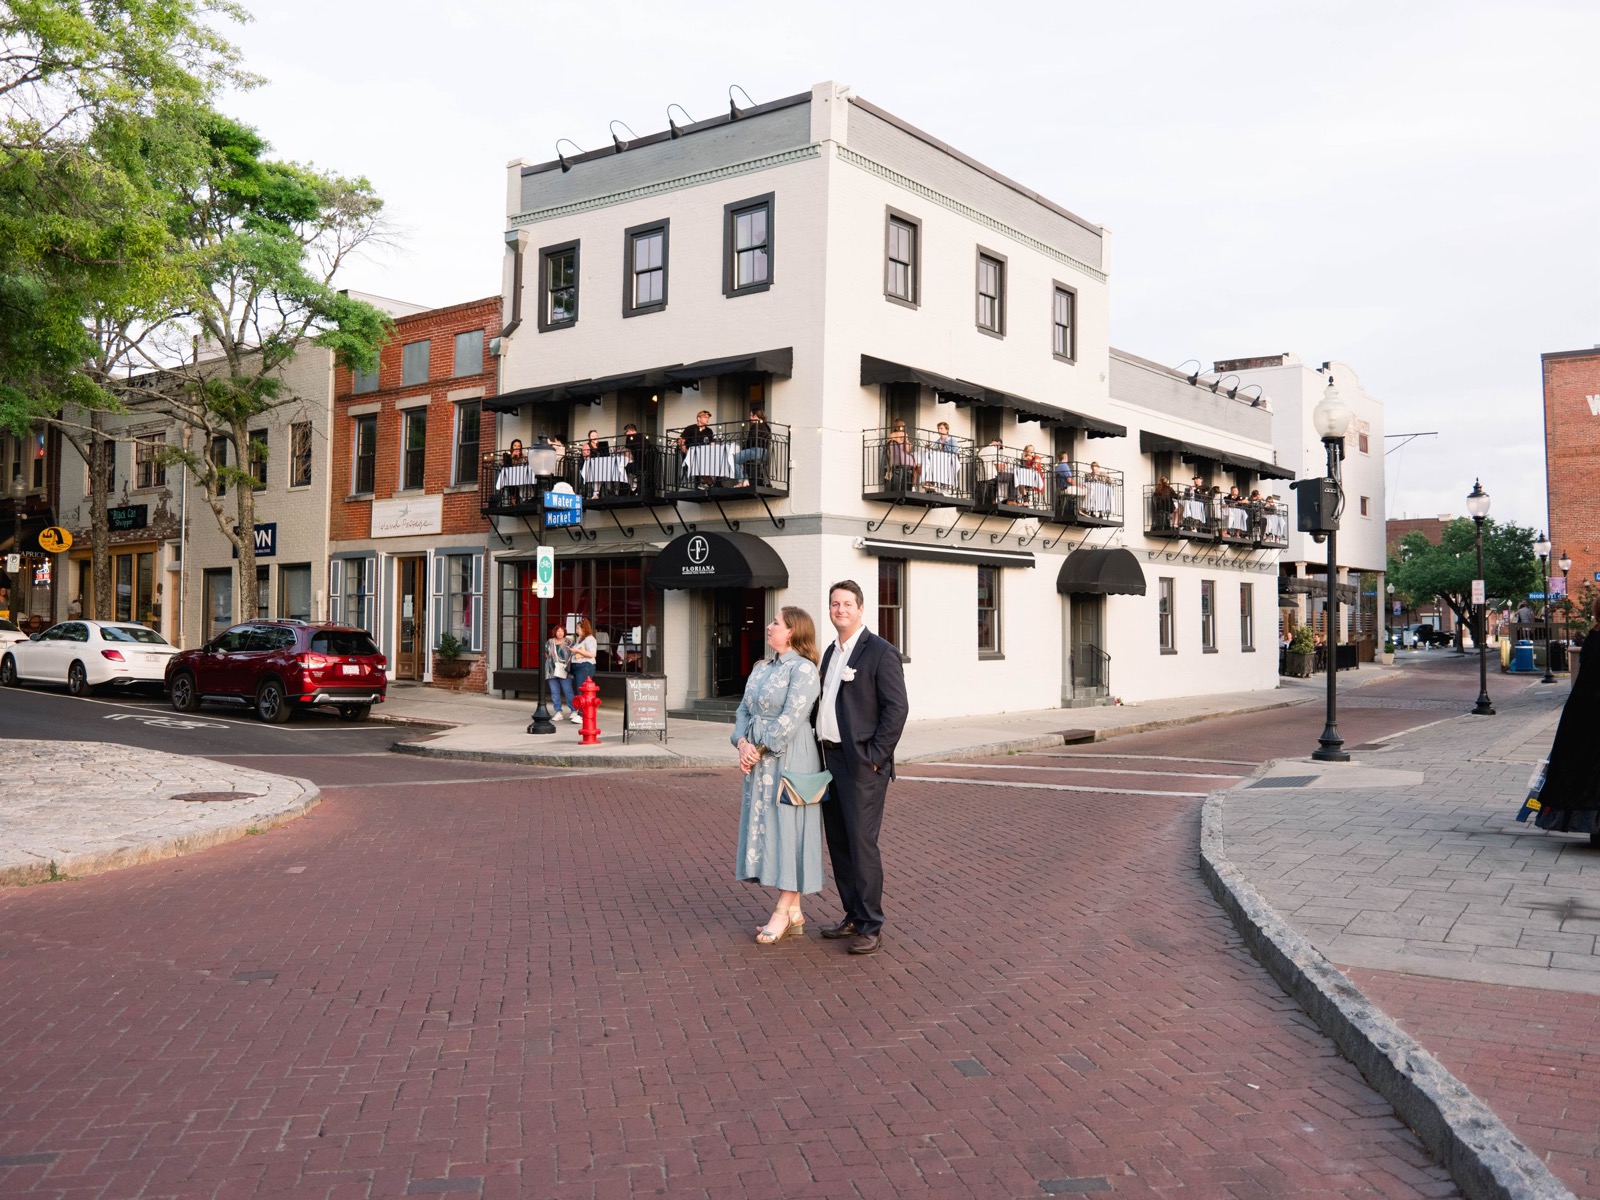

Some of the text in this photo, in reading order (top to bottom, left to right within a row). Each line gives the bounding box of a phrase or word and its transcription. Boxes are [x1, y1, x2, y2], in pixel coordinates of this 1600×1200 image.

[552, 494, 573, 507] Water
[115, 519, 133, 527] Shoppe
[547, 511, 571, 524] Market
[629, 680, 653, 690] Welcome
